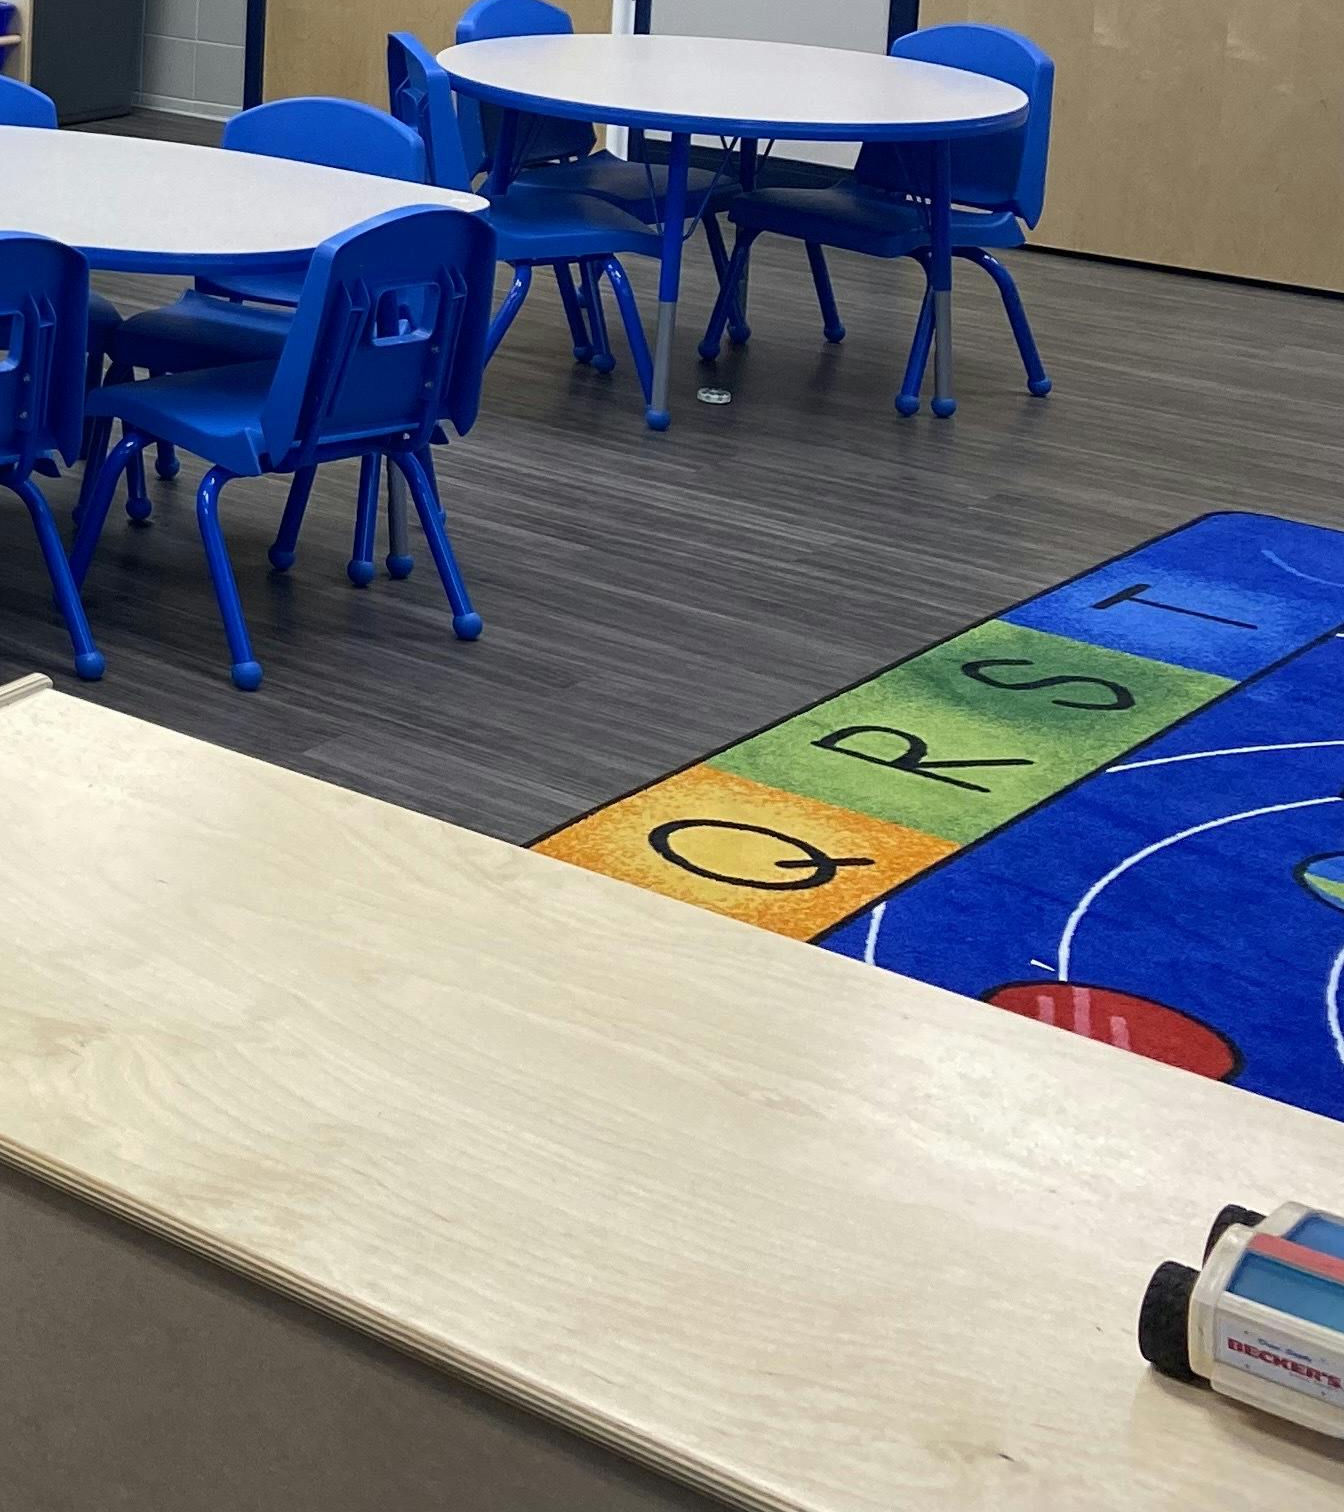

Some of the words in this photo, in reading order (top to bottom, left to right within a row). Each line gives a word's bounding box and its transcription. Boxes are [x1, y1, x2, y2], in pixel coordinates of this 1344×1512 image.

[1092, 583, 1258, 630] T
[962, 658, 1136, 711] S
[811, 725, 1034, 792] R
[647, 818, 875, 891] Q
[1227, 1337, 1342, 1389] BECKER'S
